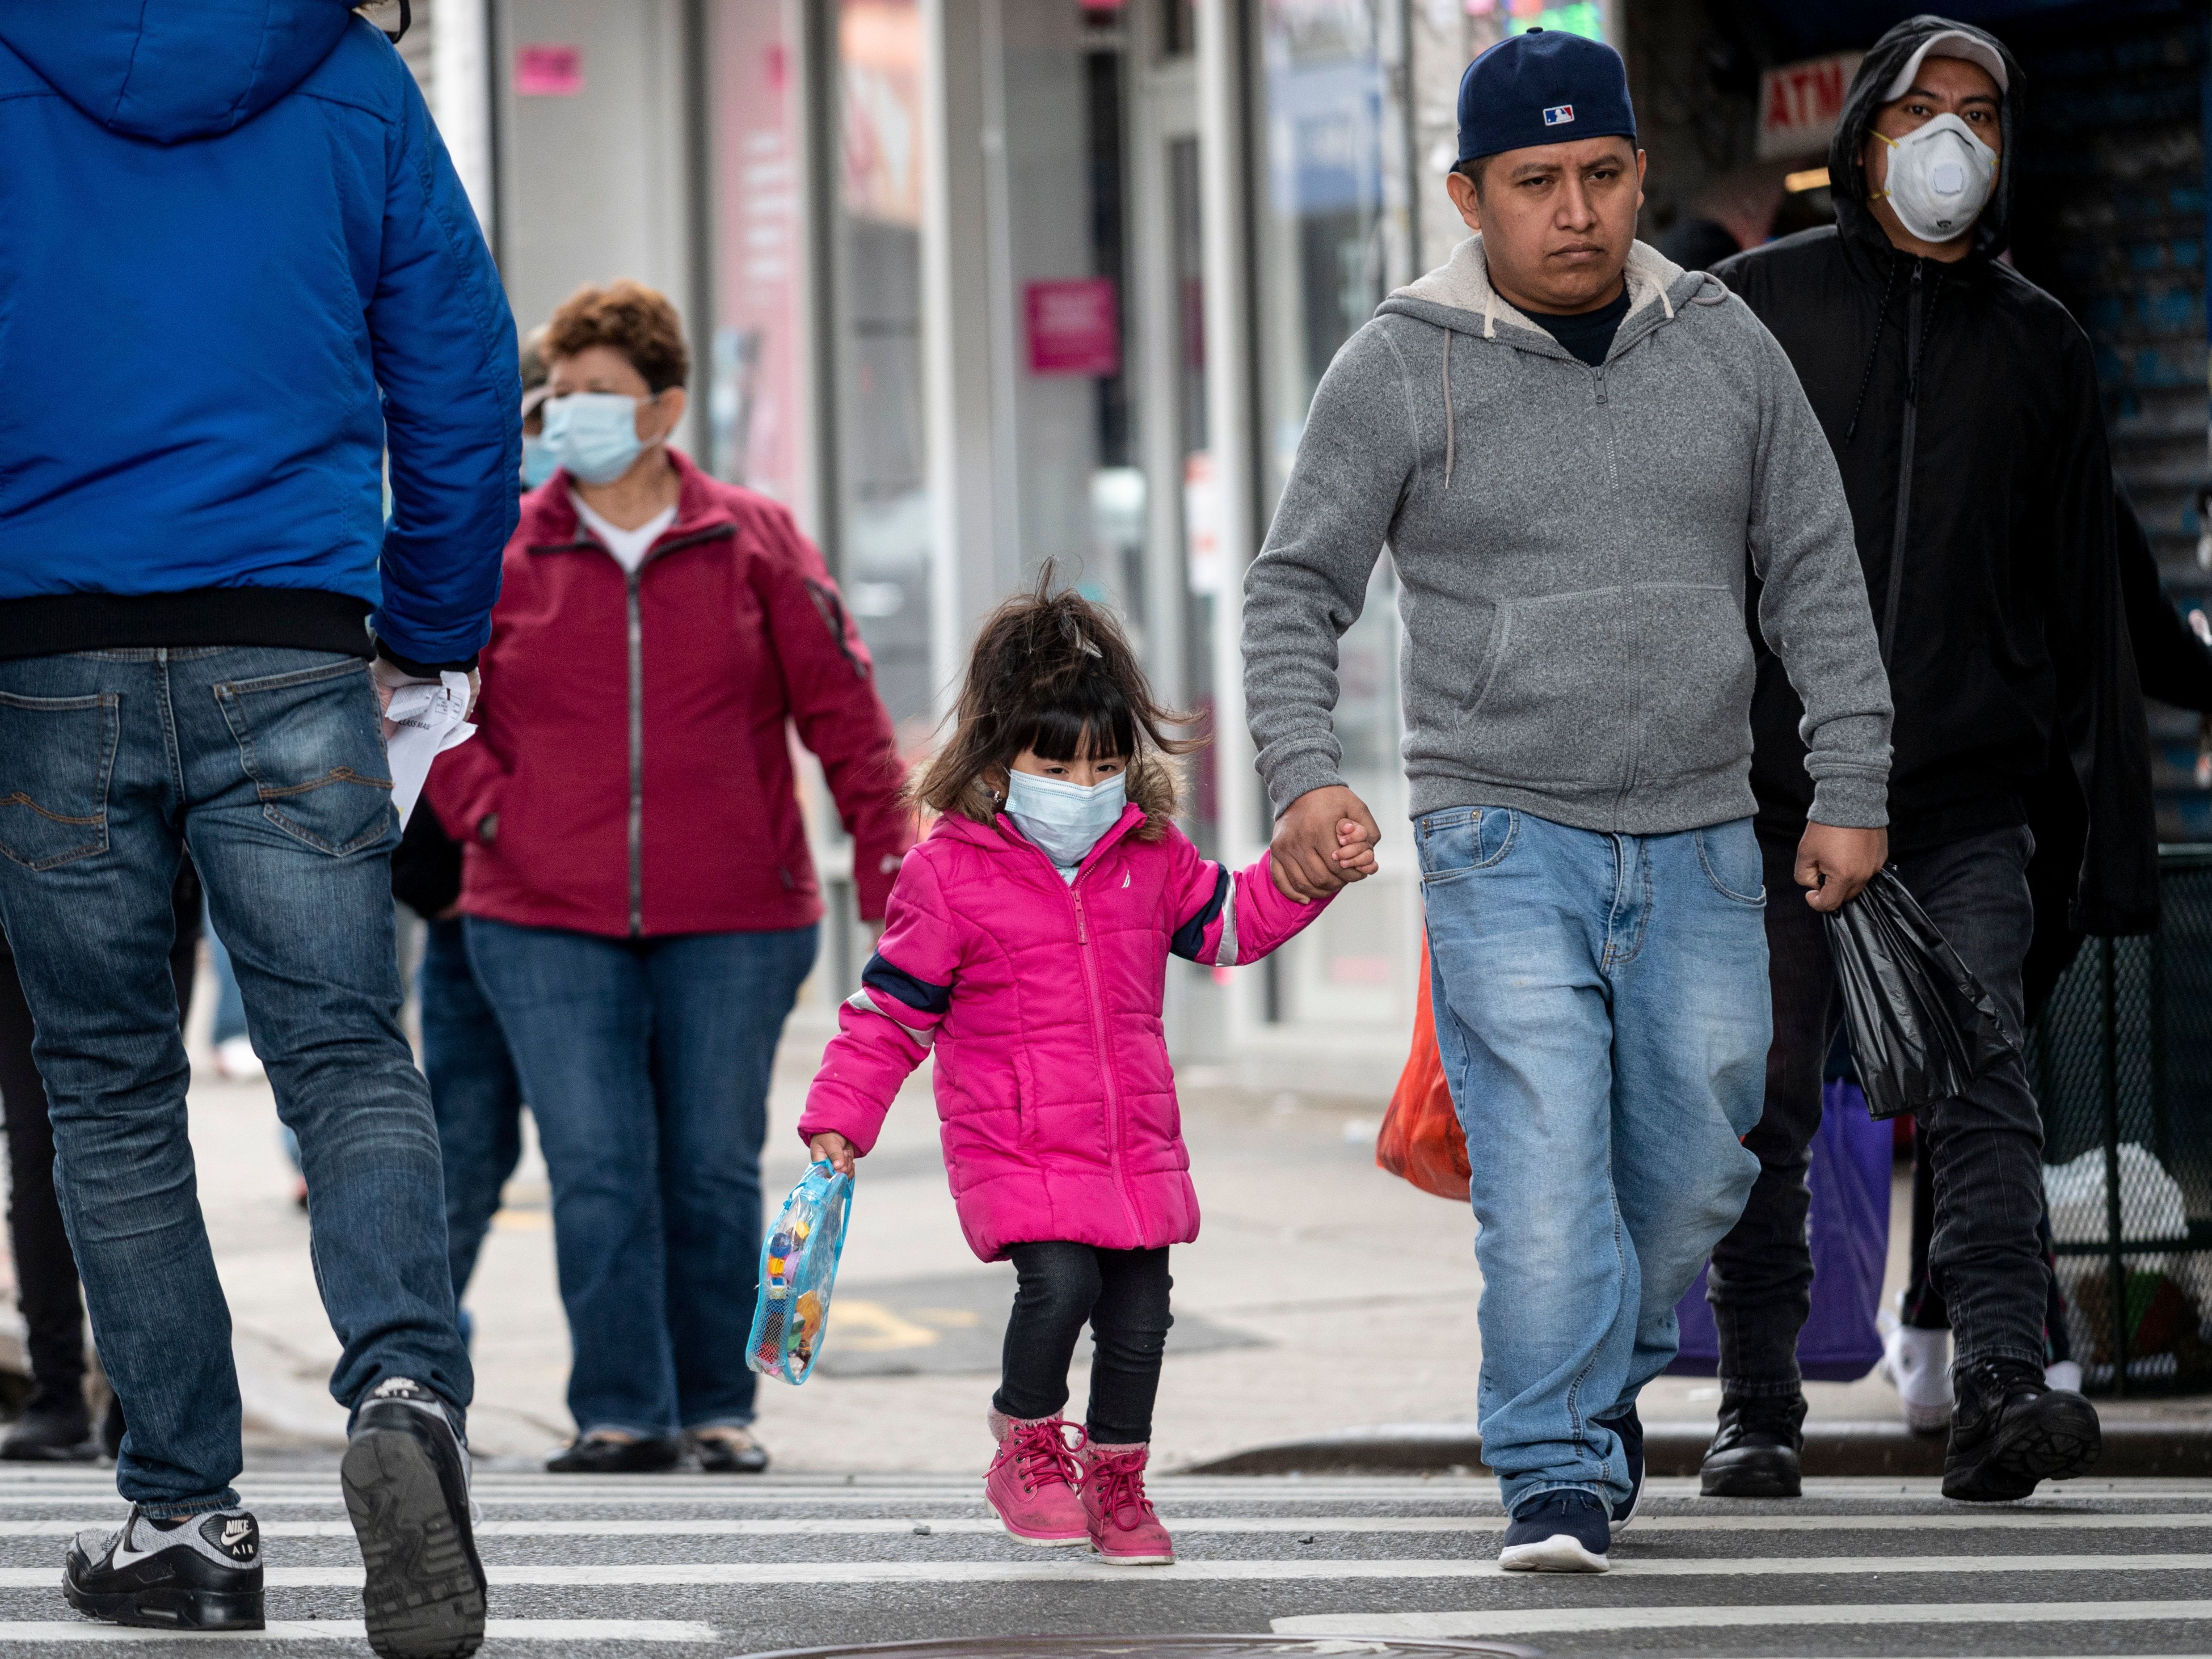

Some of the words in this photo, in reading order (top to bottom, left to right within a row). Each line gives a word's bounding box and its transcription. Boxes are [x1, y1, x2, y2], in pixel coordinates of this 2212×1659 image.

[1766, 61, 1843, 131] ATM
[226, 1519, 249, 1535] NIKE
[232, 1544, 253, 1555] AIR
